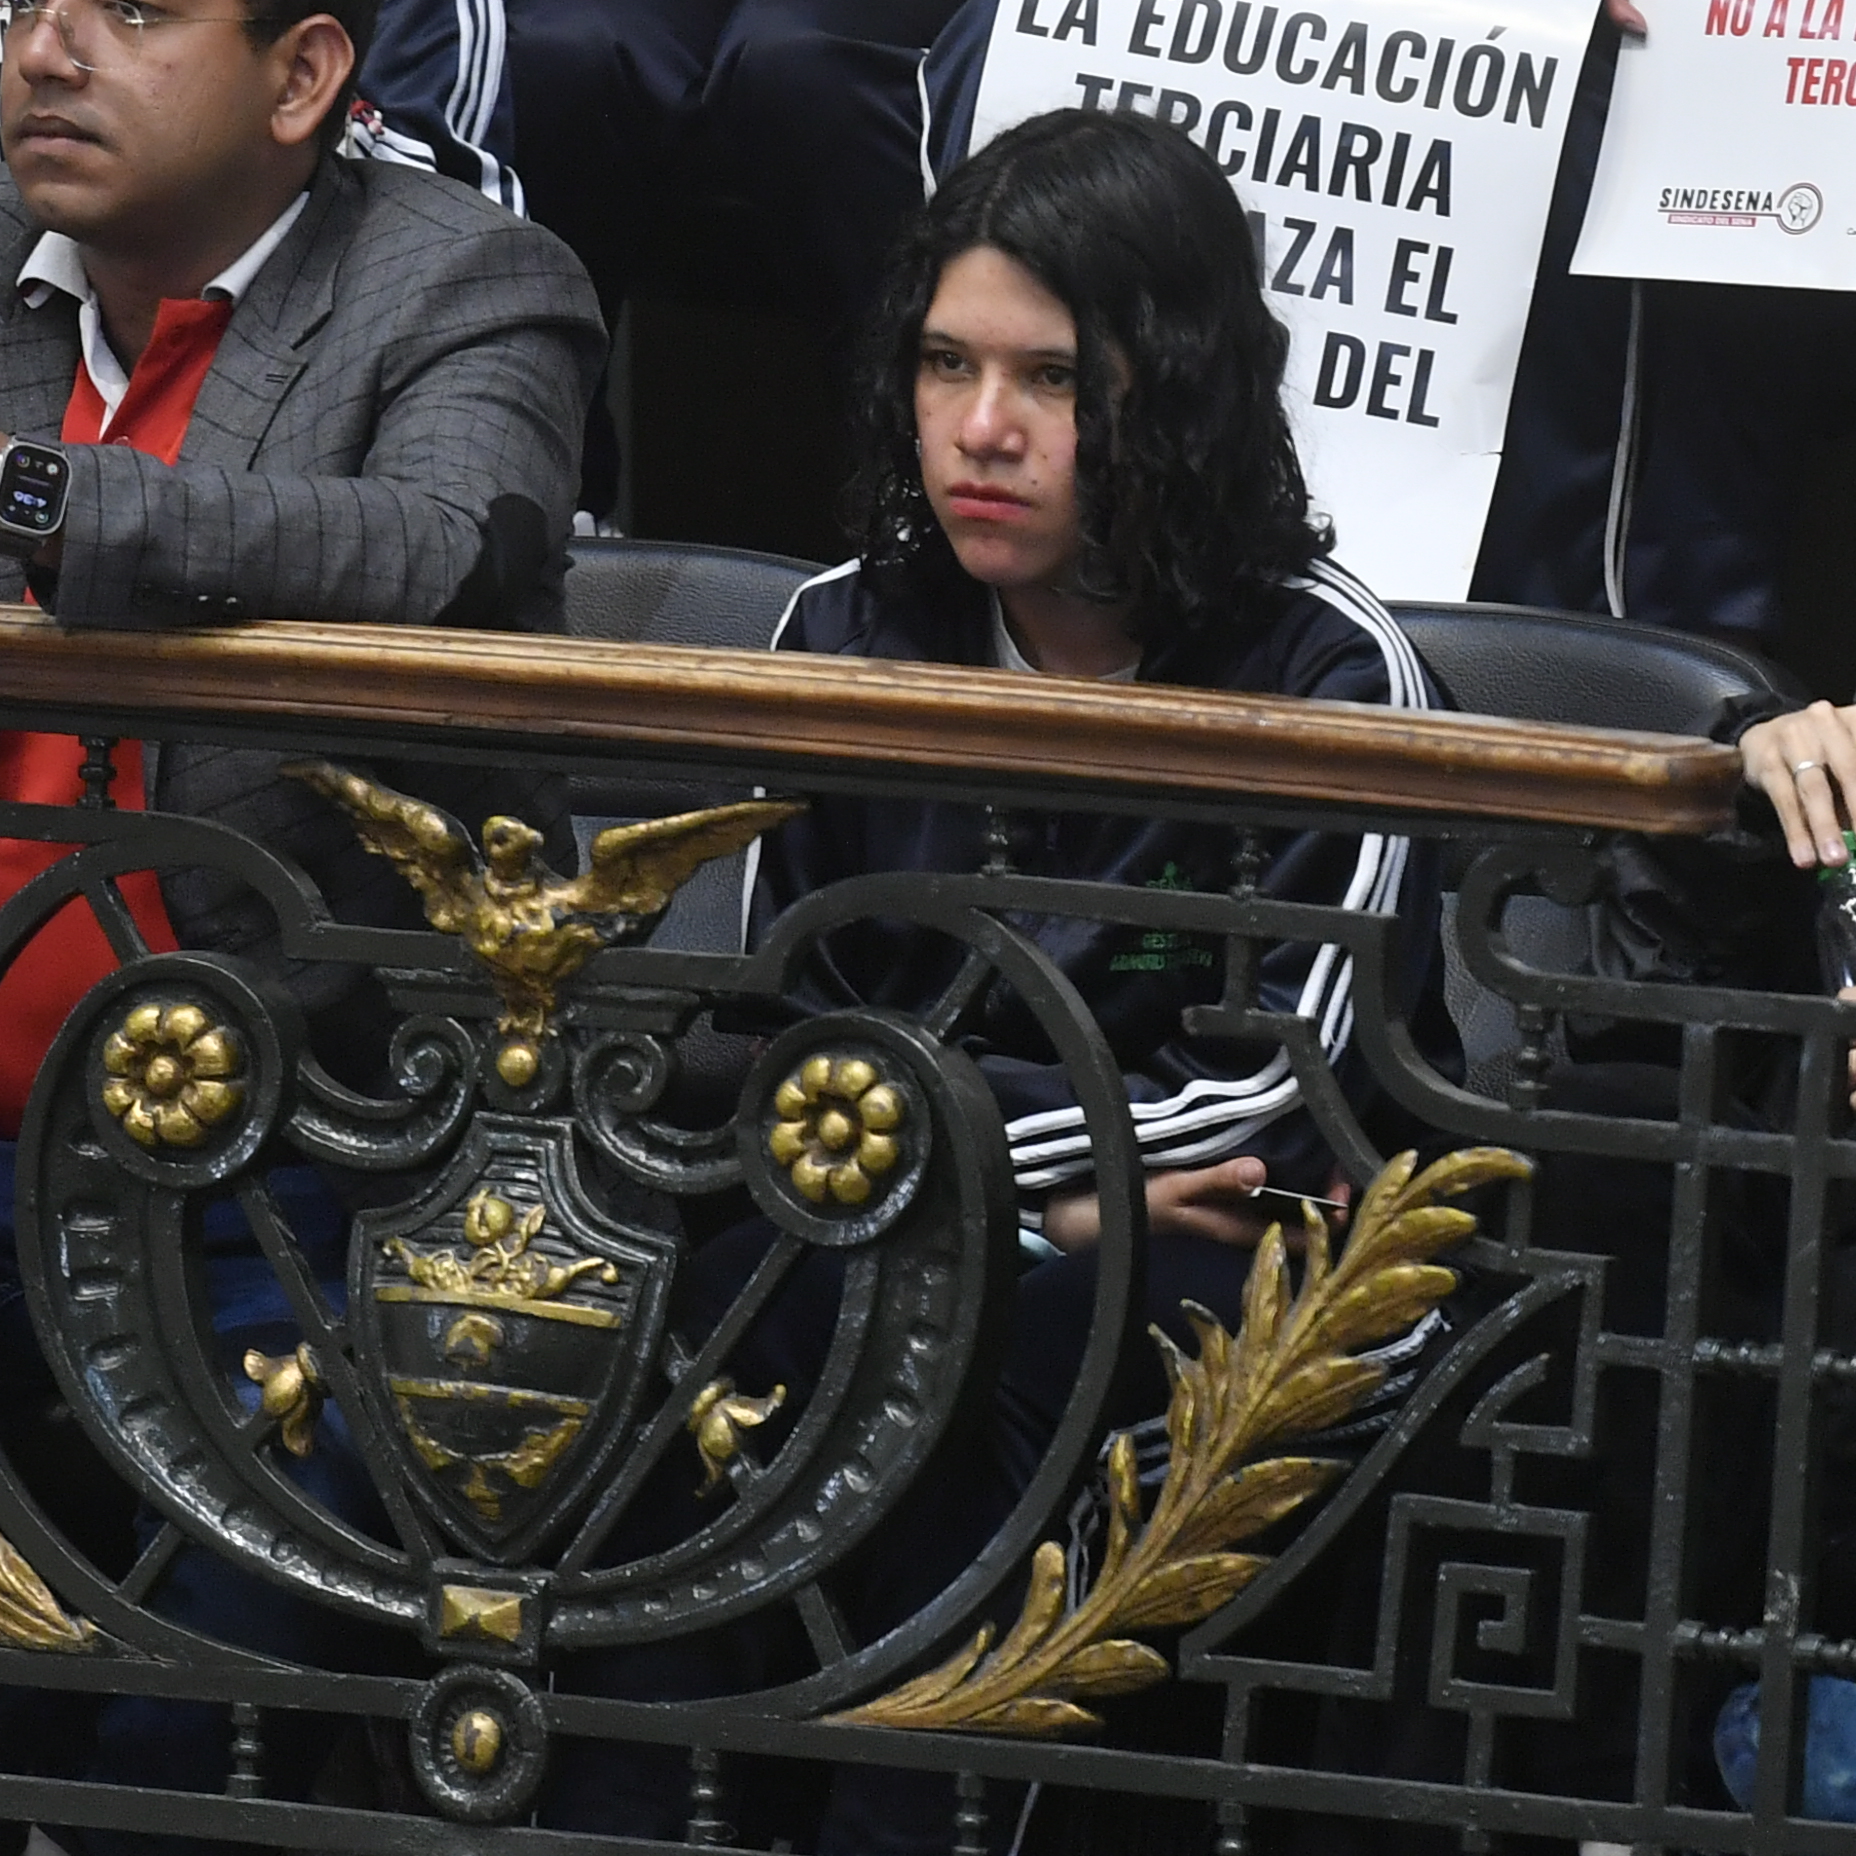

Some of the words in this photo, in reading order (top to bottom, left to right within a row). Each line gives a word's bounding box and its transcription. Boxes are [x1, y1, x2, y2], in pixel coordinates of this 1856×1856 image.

[1660, 188, 1773, 212] SINDESENA
[1385, 238, 1458, 324] EL
[1313, 331, 1439, 427] DEL
